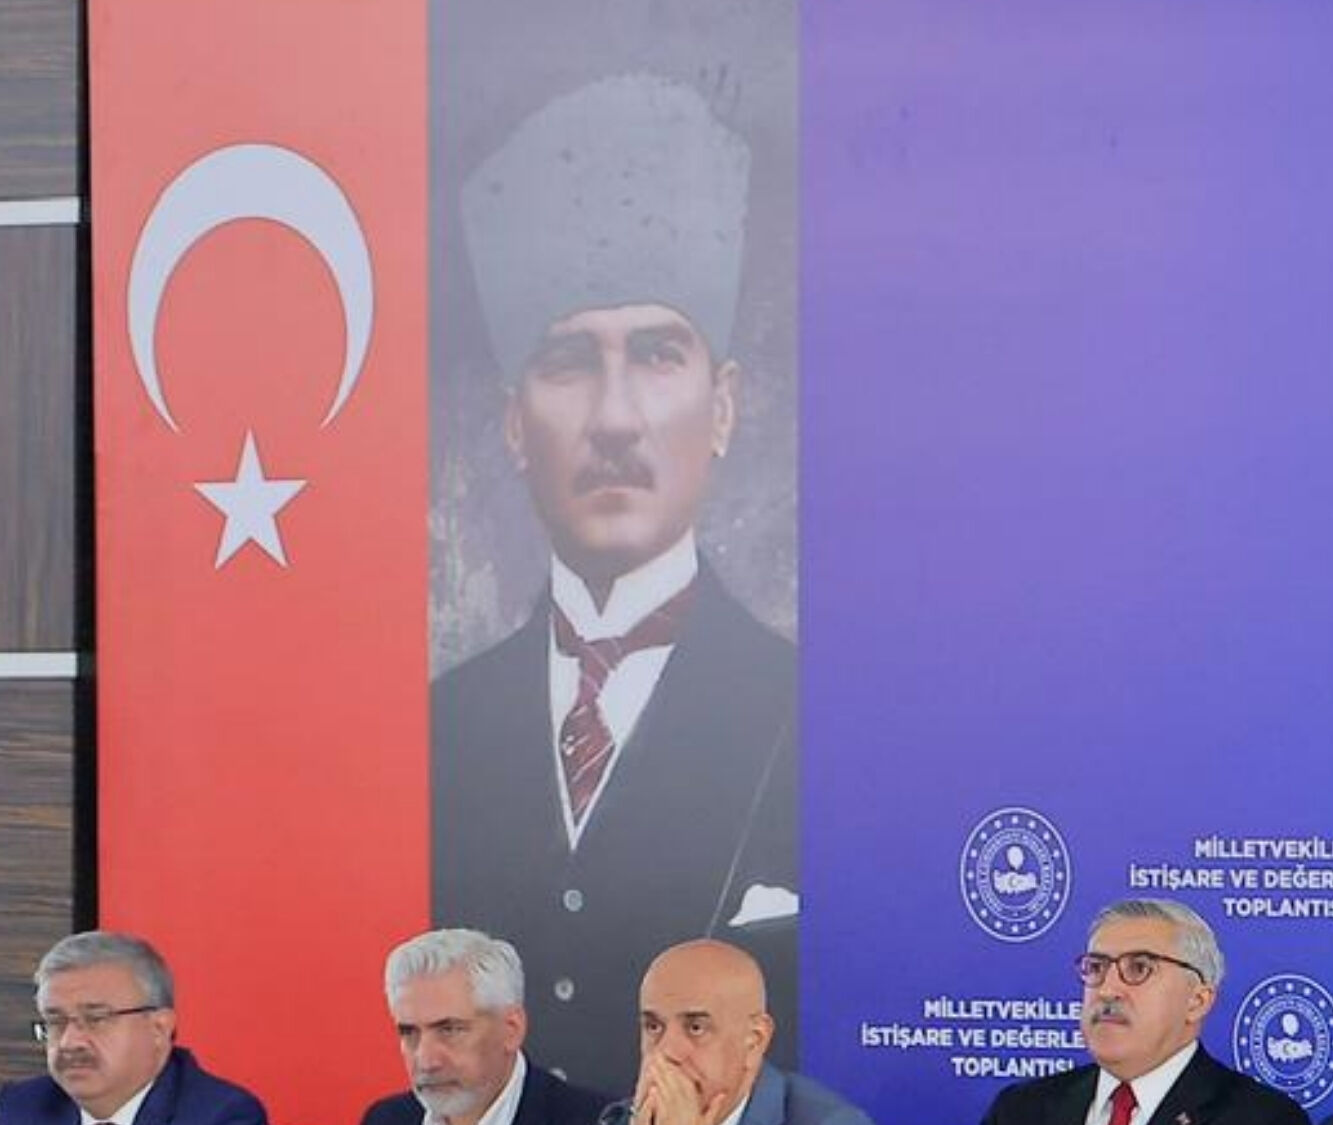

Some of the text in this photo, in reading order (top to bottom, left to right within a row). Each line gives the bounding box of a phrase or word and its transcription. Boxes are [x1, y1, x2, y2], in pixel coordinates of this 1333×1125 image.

[1130, 863, 1225, 891] İSTİŞARE
[1229, 869, 1258, 889] VE
[924, 996, 1082, 1020] MİLLETVEKİLLE
[861, 1023, 953, 1049] İSTİŞARE
[957, 1028, 986, 1047] VE
